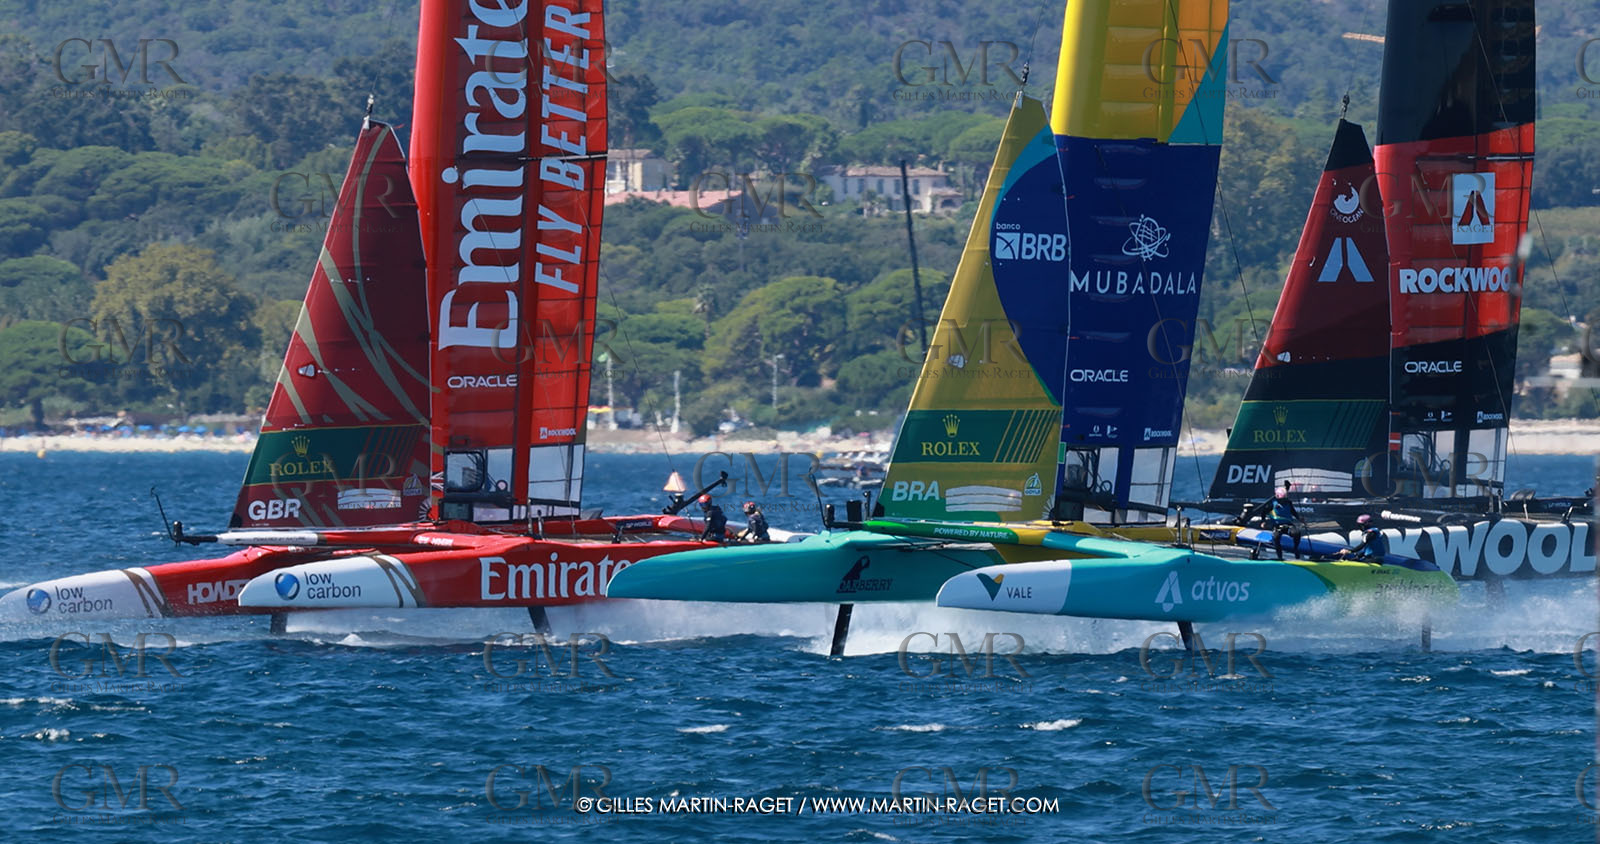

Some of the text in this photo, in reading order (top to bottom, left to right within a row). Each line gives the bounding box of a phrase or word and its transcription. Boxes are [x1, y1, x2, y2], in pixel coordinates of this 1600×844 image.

[535, 5, 590, 294] FLY BETTER
[996, 222, 1021, 230] banco
[1021, 233, 1067, 262] BRB
[1070, 270, 1197, 295] MUBADALA
[1399, 266, 1512, 294] ROCKWOO
[1405, 360, 1463, 373] ORACLE
[447, 375, 518, 388] ORACLE
[1070, 369, 1129, 382] ORACLE
[1253, 429, 1307, 443] ROLEX
[921, 441, 981, 456] ROLEX
[269, 460, 334, 477] ROLEX
[1227, 465, 1272, 484] DEN
[892, 480, 940, 501] BRA
[248, 498, 301, 520] GBR
[934, 527, 968, 537] POWERED
[969, 529, 979, 537] BY
[304, 571, 332, 585] low
[479, 552, 645, 600] Emirat
[55, 586, 83, 600] low
[307, 583, 361, 599] carbon
[1007, 587, 1032, 599] VALE
[1191, 576, 1250, 602] atvos
[58, 597, 113, 614] carbon
